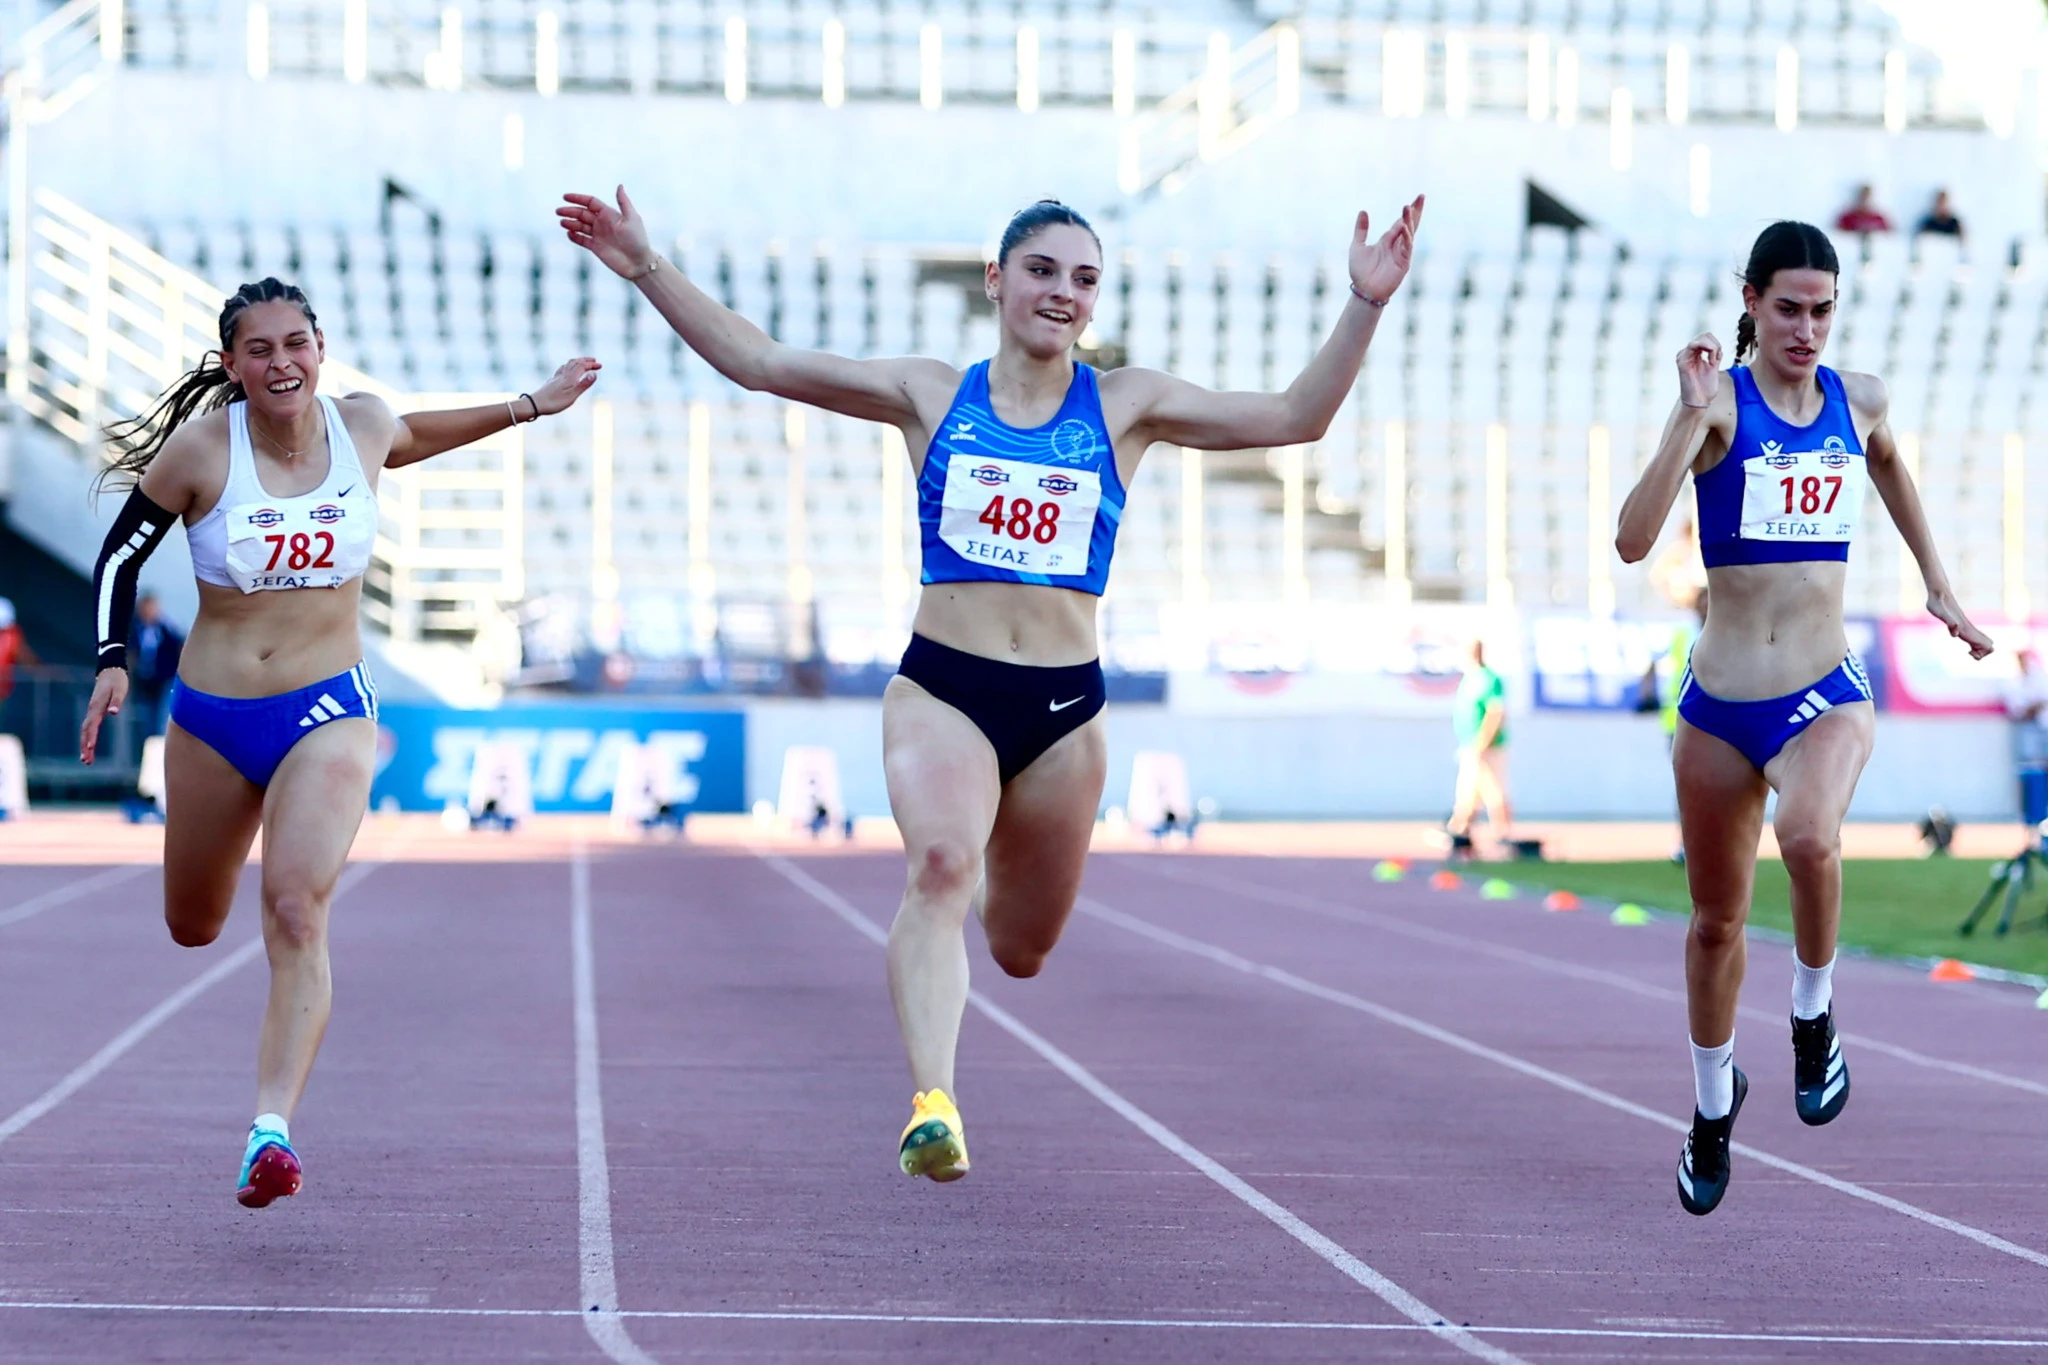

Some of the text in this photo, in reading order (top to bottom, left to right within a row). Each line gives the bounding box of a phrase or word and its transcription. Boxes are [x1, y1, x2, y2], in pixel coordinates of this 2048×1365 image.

[949, 432, 977, 442] erima
[1780, 476, 1843, 515] 187
[978, 494, 1061, 545] 488
[1765, 521, 1821, 535] ΣΕΓΑΣ
[264, 531, 335, 572] 782
[965, 540, 1030, 566] ΣΕΓΑΣ
[250, 576, 311, 588] ΣΕΓΑΣ
